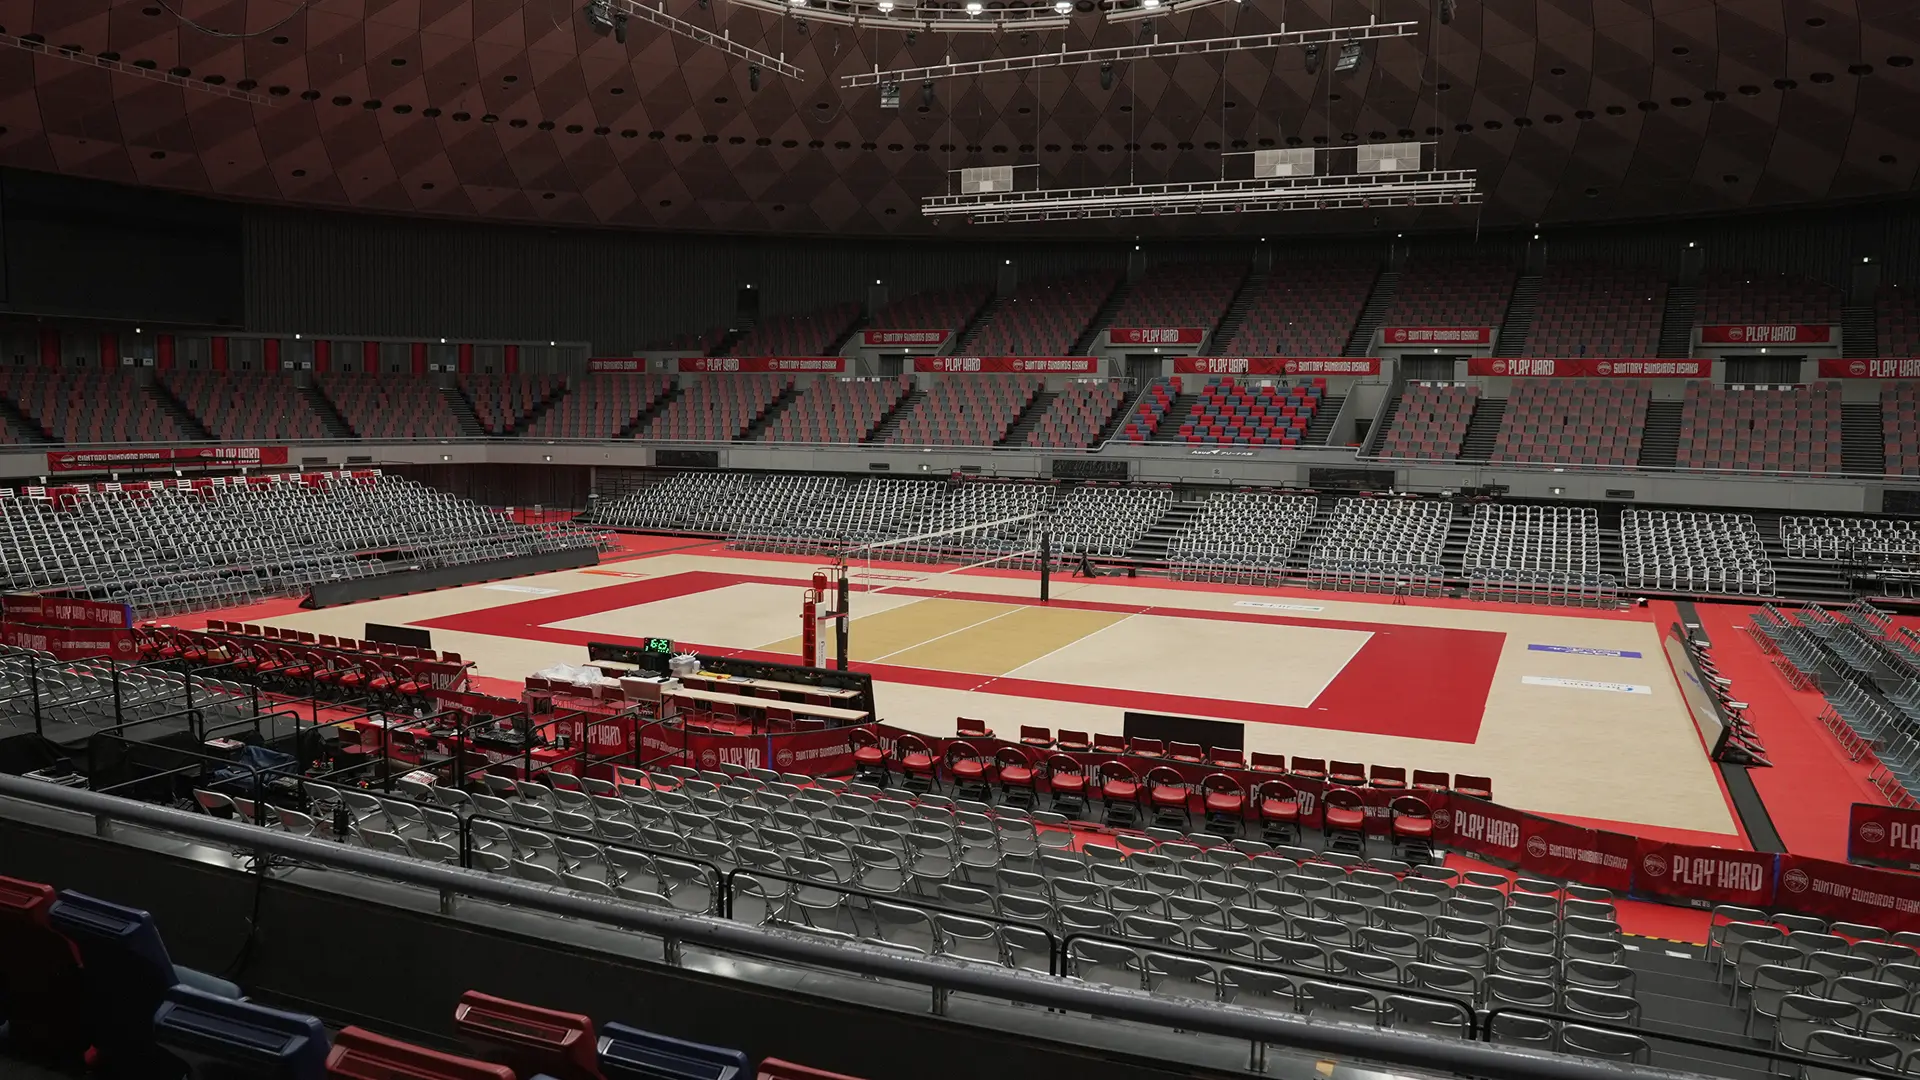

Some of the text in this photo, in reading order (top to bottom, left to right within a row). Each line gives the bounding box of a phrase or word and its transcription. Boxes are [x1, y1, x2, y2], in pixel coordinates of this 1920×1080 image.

[883, 333, 903, 341] SUNTORY
[925, 333, 940, 341] OSAKA
[1142, 329, 1179, 342] PLAY HARD
[1408, 330, 1479, 340] SUNTORY SUNBIRDS OSAKA
[1746, 328, 1796, 341] PLAY HARD
[707, 358, 722, 371] PLAY
[945, 358, 962, 371] PLAY
[963, 358, 980, 371] HARD
[1025, 360, 1047, 370] SUNTORY
[1072, 360, 1088, 370] OSAKA
[1208, 359, 1370, 373] PLAY HARD SUNTORY SUNBIRDS OSAKA
[1509, 360, 1698, 375] PLAY HARD SUNTORY SUNBIRDS OSAKA
[1869, 360, 1897, 377] PLAY
[598, 724, 621, 746] HARD
[796, 750, 819, 760] SUNTORY
[1454, 810, 1485, 840] PLAY
[1486, 819, 1519, 848] HARD
[1549, 844, 1577, 860] SUNTORY
[1603, 854, 1629, 870] OSAKA
[1672, 855, 1763, 892] PLAY HARD
[1812, 879, 1852, 899] SUNTORY
[1851, 888, 1895, 909] SUNBIRDS
